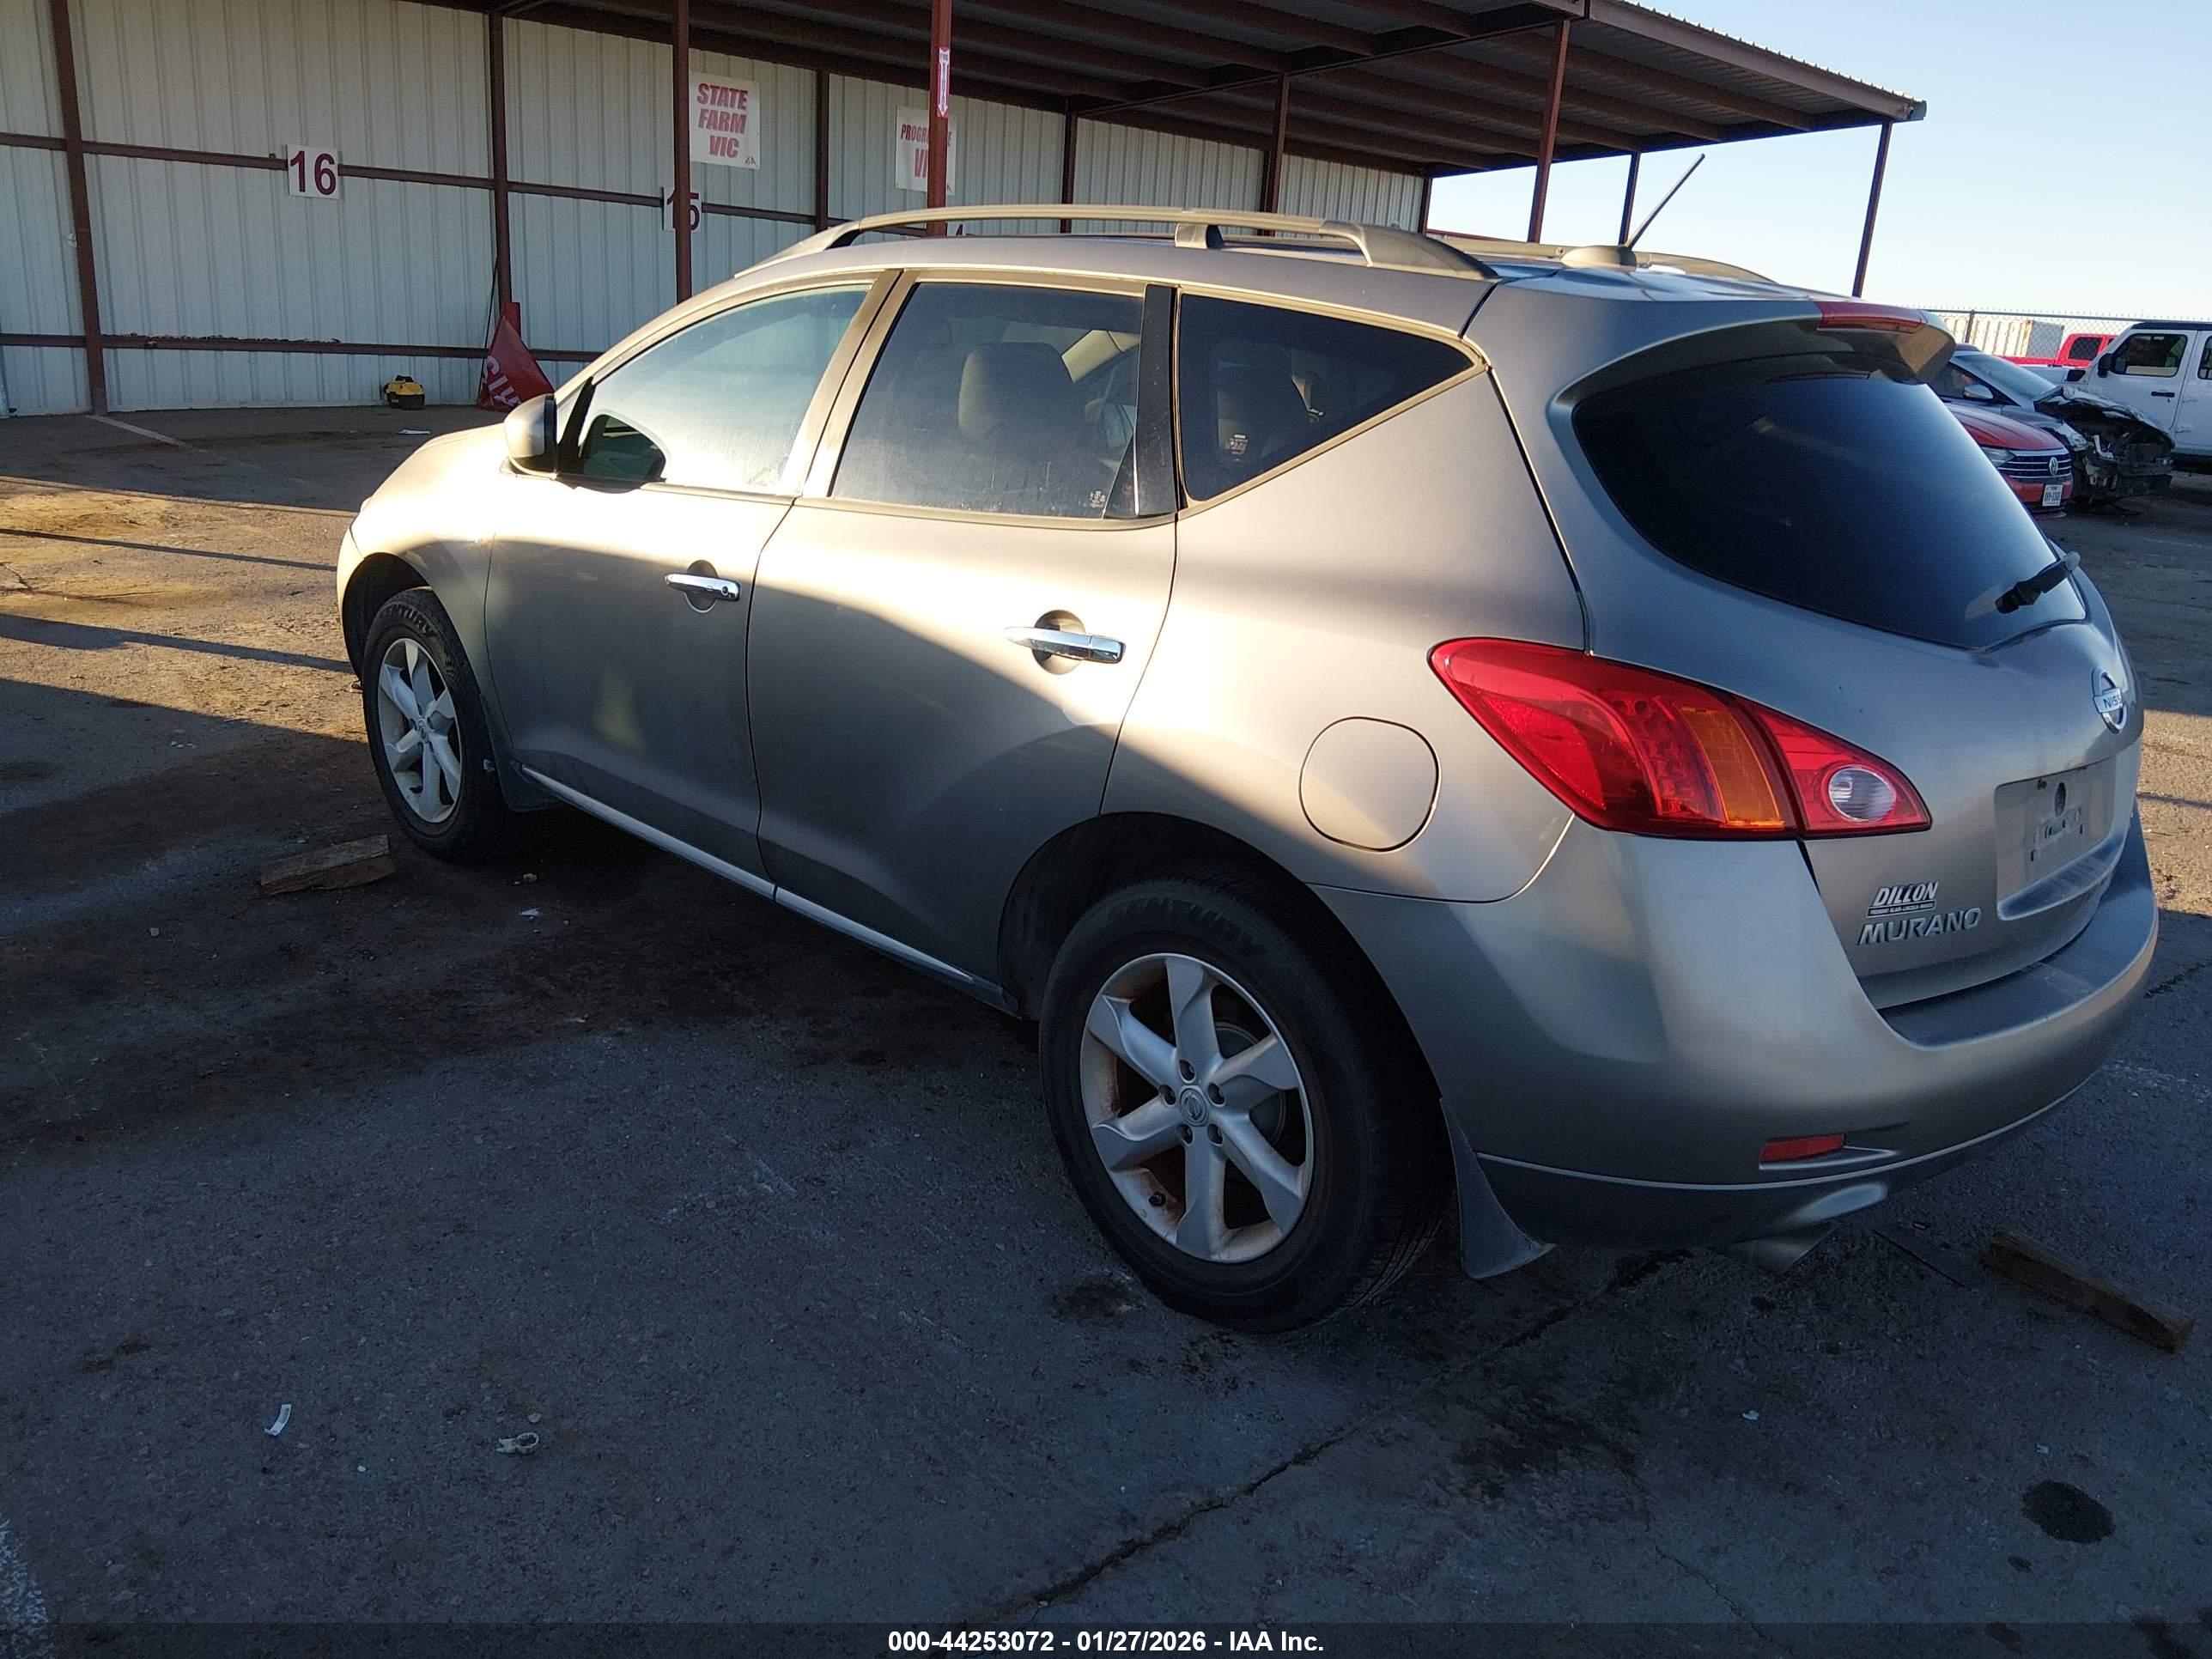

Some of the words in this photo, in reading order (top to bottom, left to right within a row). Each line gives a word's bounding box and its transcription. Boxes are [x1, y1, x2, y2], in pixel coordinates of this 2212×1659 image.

[696, 82, 748, 111] STATE
[697, 108, 747, 135] FARM
[709, 135, 739, 159] VIC
[901, 124, 952, 147] PROGRE
[289, 150, 337, 196] 16
[1872, 880, 1939, 907] DILLON
[1857, 908, 1982, 945] MURANO
